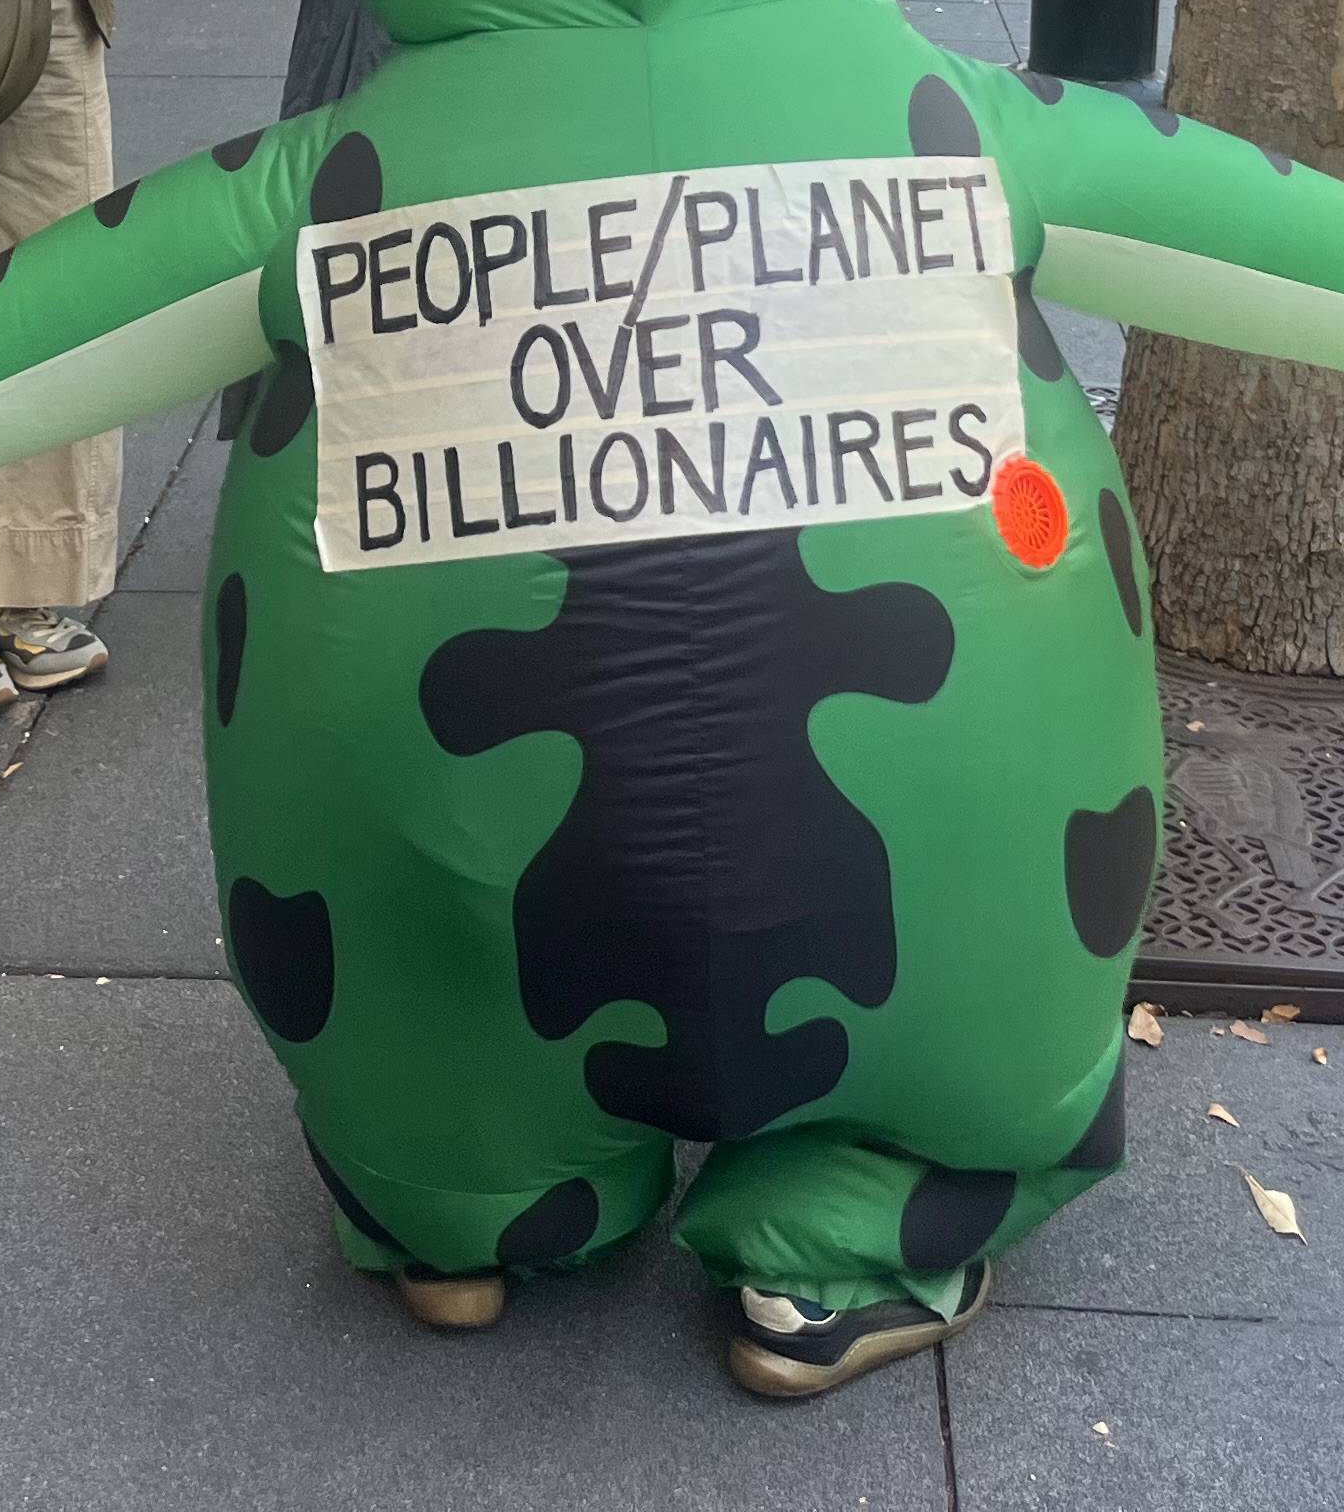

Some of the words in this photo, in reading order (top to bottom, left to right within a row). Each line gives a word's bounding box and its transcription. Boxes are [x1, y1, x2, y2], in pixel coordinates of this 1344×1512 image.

[311, 174, 987, 344] PEOPLE/PLANET
[510, 308, 784, 429] OVER
[355, 403, 993, 552] BILLIONAIRES
